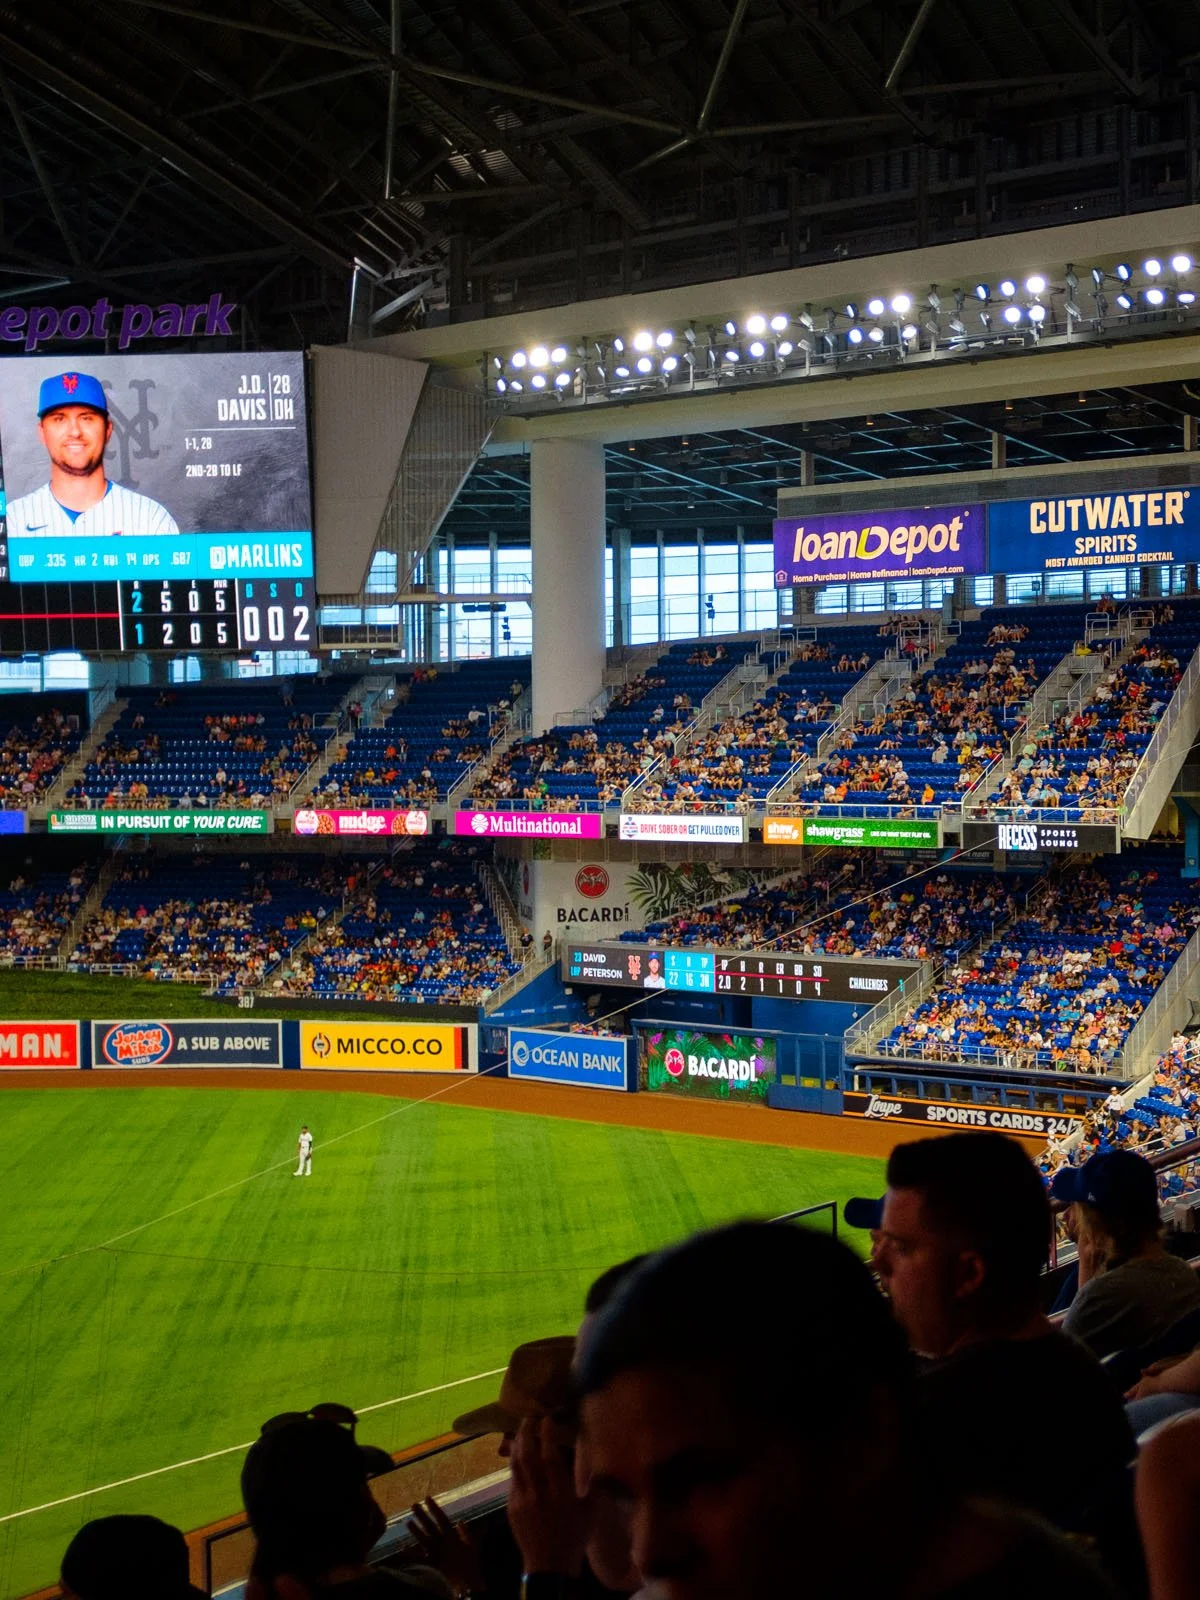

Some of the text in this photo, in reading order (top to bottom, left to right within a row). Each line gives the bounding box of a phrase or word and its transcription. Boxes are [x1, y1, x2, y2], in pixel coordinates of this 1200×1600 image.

[118, 293, 237, 349] park
[238, 374, 291, 394] J.D. 28
[217, 398, 294, 421] DAVIS DH
[220, 464, 231, 477] TO
[232, 463, 242, 476] LF
[1030, 491, 1185, 534] CUTWATER
[792, 518, 964, 563] loanDepot
[1075, 534, 1138, 555] SPIRITS
[92, 553, 98, 566] 2
[143, 553, 159, 566] OPS
[209, 543, 303, 570] @MARLINS
[1045, 552, 1174, 568] MOST AWARDED CANNED COCKTAIL
[793, 565, 964, 583] Home Purchase Home Refinance loanDepot.com
[269, 583, 277, 598] S
[132, 590, 225, 612] 2 5 0 5
[243, 605, 310, 641] 0 0 2
[135, 623, 227, 645] 1 2 0 5
[101, 815, 113, 829] IN
[117, 815, 171, 829] PURSUIT
[174, 815, 190, 829] OF
[193, 815, 225, 829] YOUR
[490, 815, 582, 835] Multinational
[640, 823, 657, 834] DRIVE
[659, 823, 678, 835] SOBER
[679, 824, 687, 835] OR
[688, 824, 699, 835] GET
[700, 824, 723, 836] PULLED
[724, 825, 740, 836] OVER
[806, 824, 865, 840] shawgrass
[998, 824, 1038, 850] RECESS
[1040, 829, 1077, 838] SPORTS
[1040, 839, 1079, 848] LOUNGE
[583, 952, 607, 964] DAVID
[583, 967, 623, 979] PETERSON
[776, 962, 784, 975] ER
[669, 971, 678, 985] 22
[718, 975, 731, 990] 2.0
[740, 976, 746, 991] 2
[796, 980, 802, 995] 0
[814, 981, 821, 996] 4
[849, 977, 889, 992] CHALLENGES
[112, 1028, 163, 1046] Jersey
[177, 1036, 270, 1051] A SUB ABOVE
[337, 1038, 443, 1056] MICCO.CO
[131, 1056, 151, 1065] SUBS
[531, 1046, 622, 1073] OCEAN BANK
[864, 1093, 902, 1118] Loupe
[926, 1105, 987, 1126] SPORTS
[990, 1111, 1044, 1132] CARDS
